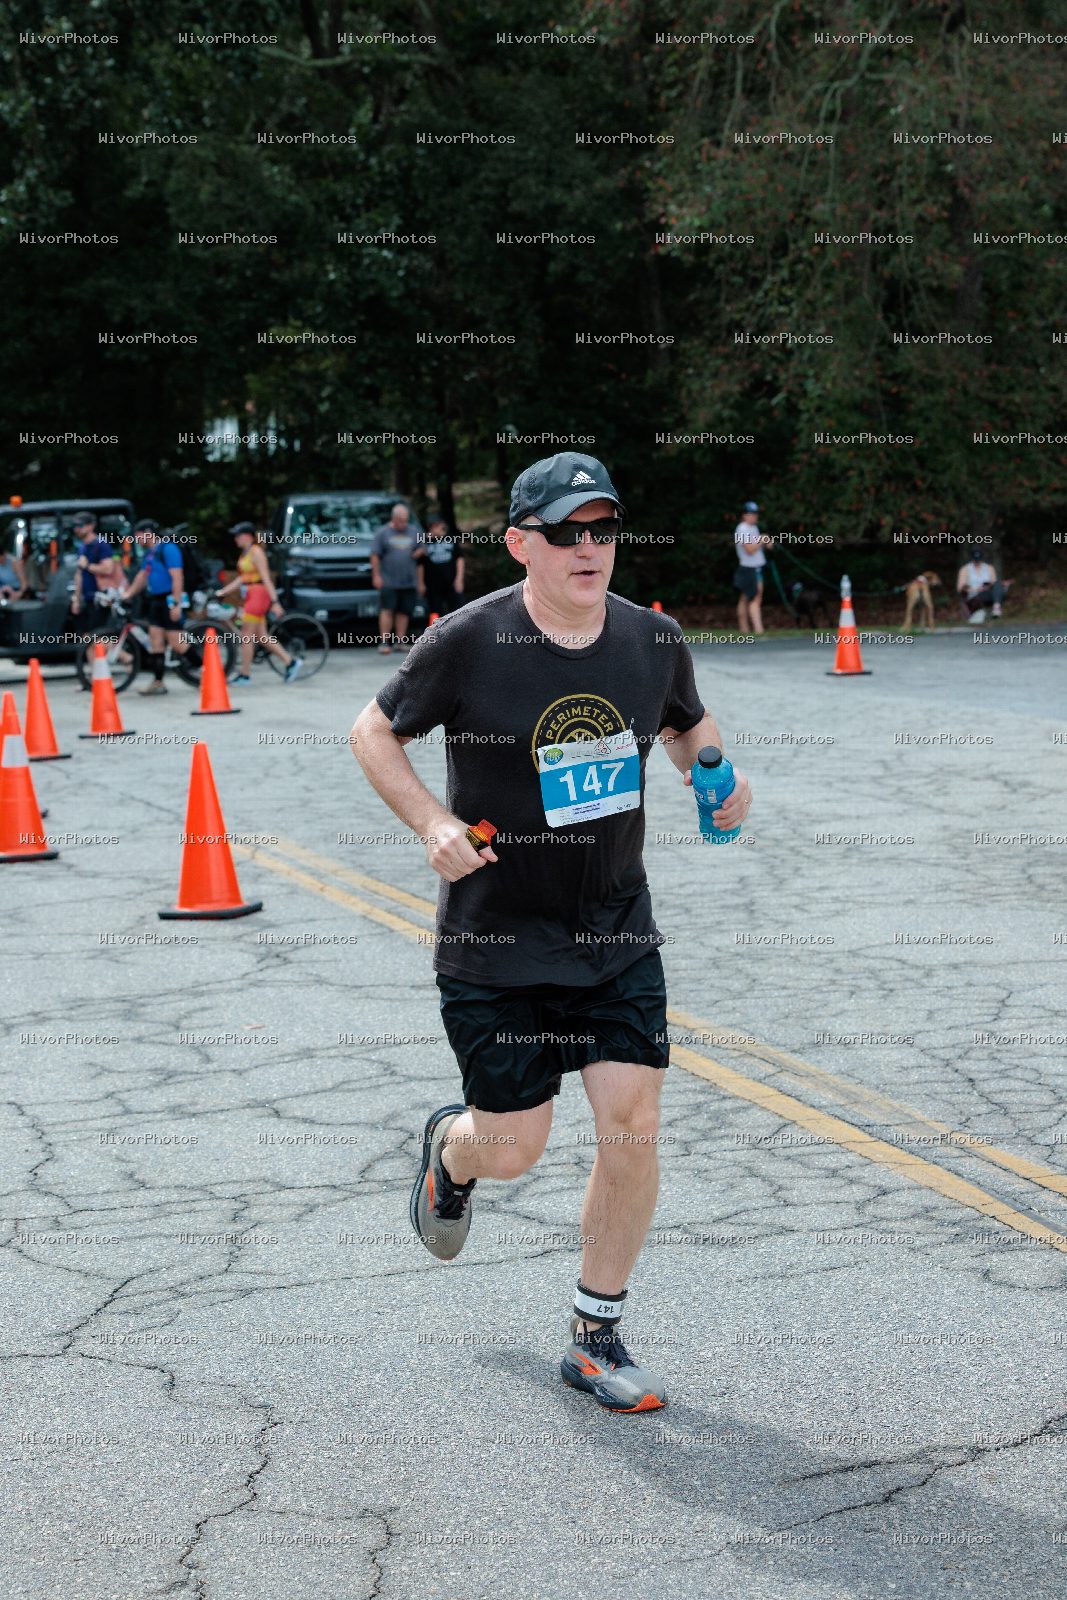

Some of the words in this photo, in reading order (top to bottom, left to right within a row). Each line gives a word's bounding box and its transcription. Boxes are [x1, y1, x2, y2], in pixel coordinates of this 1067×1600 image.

[545, 705, 614, 740] PERIMETER
[559, 761, 625, 802] 147
[596, 1304, 615, 1315] 147
